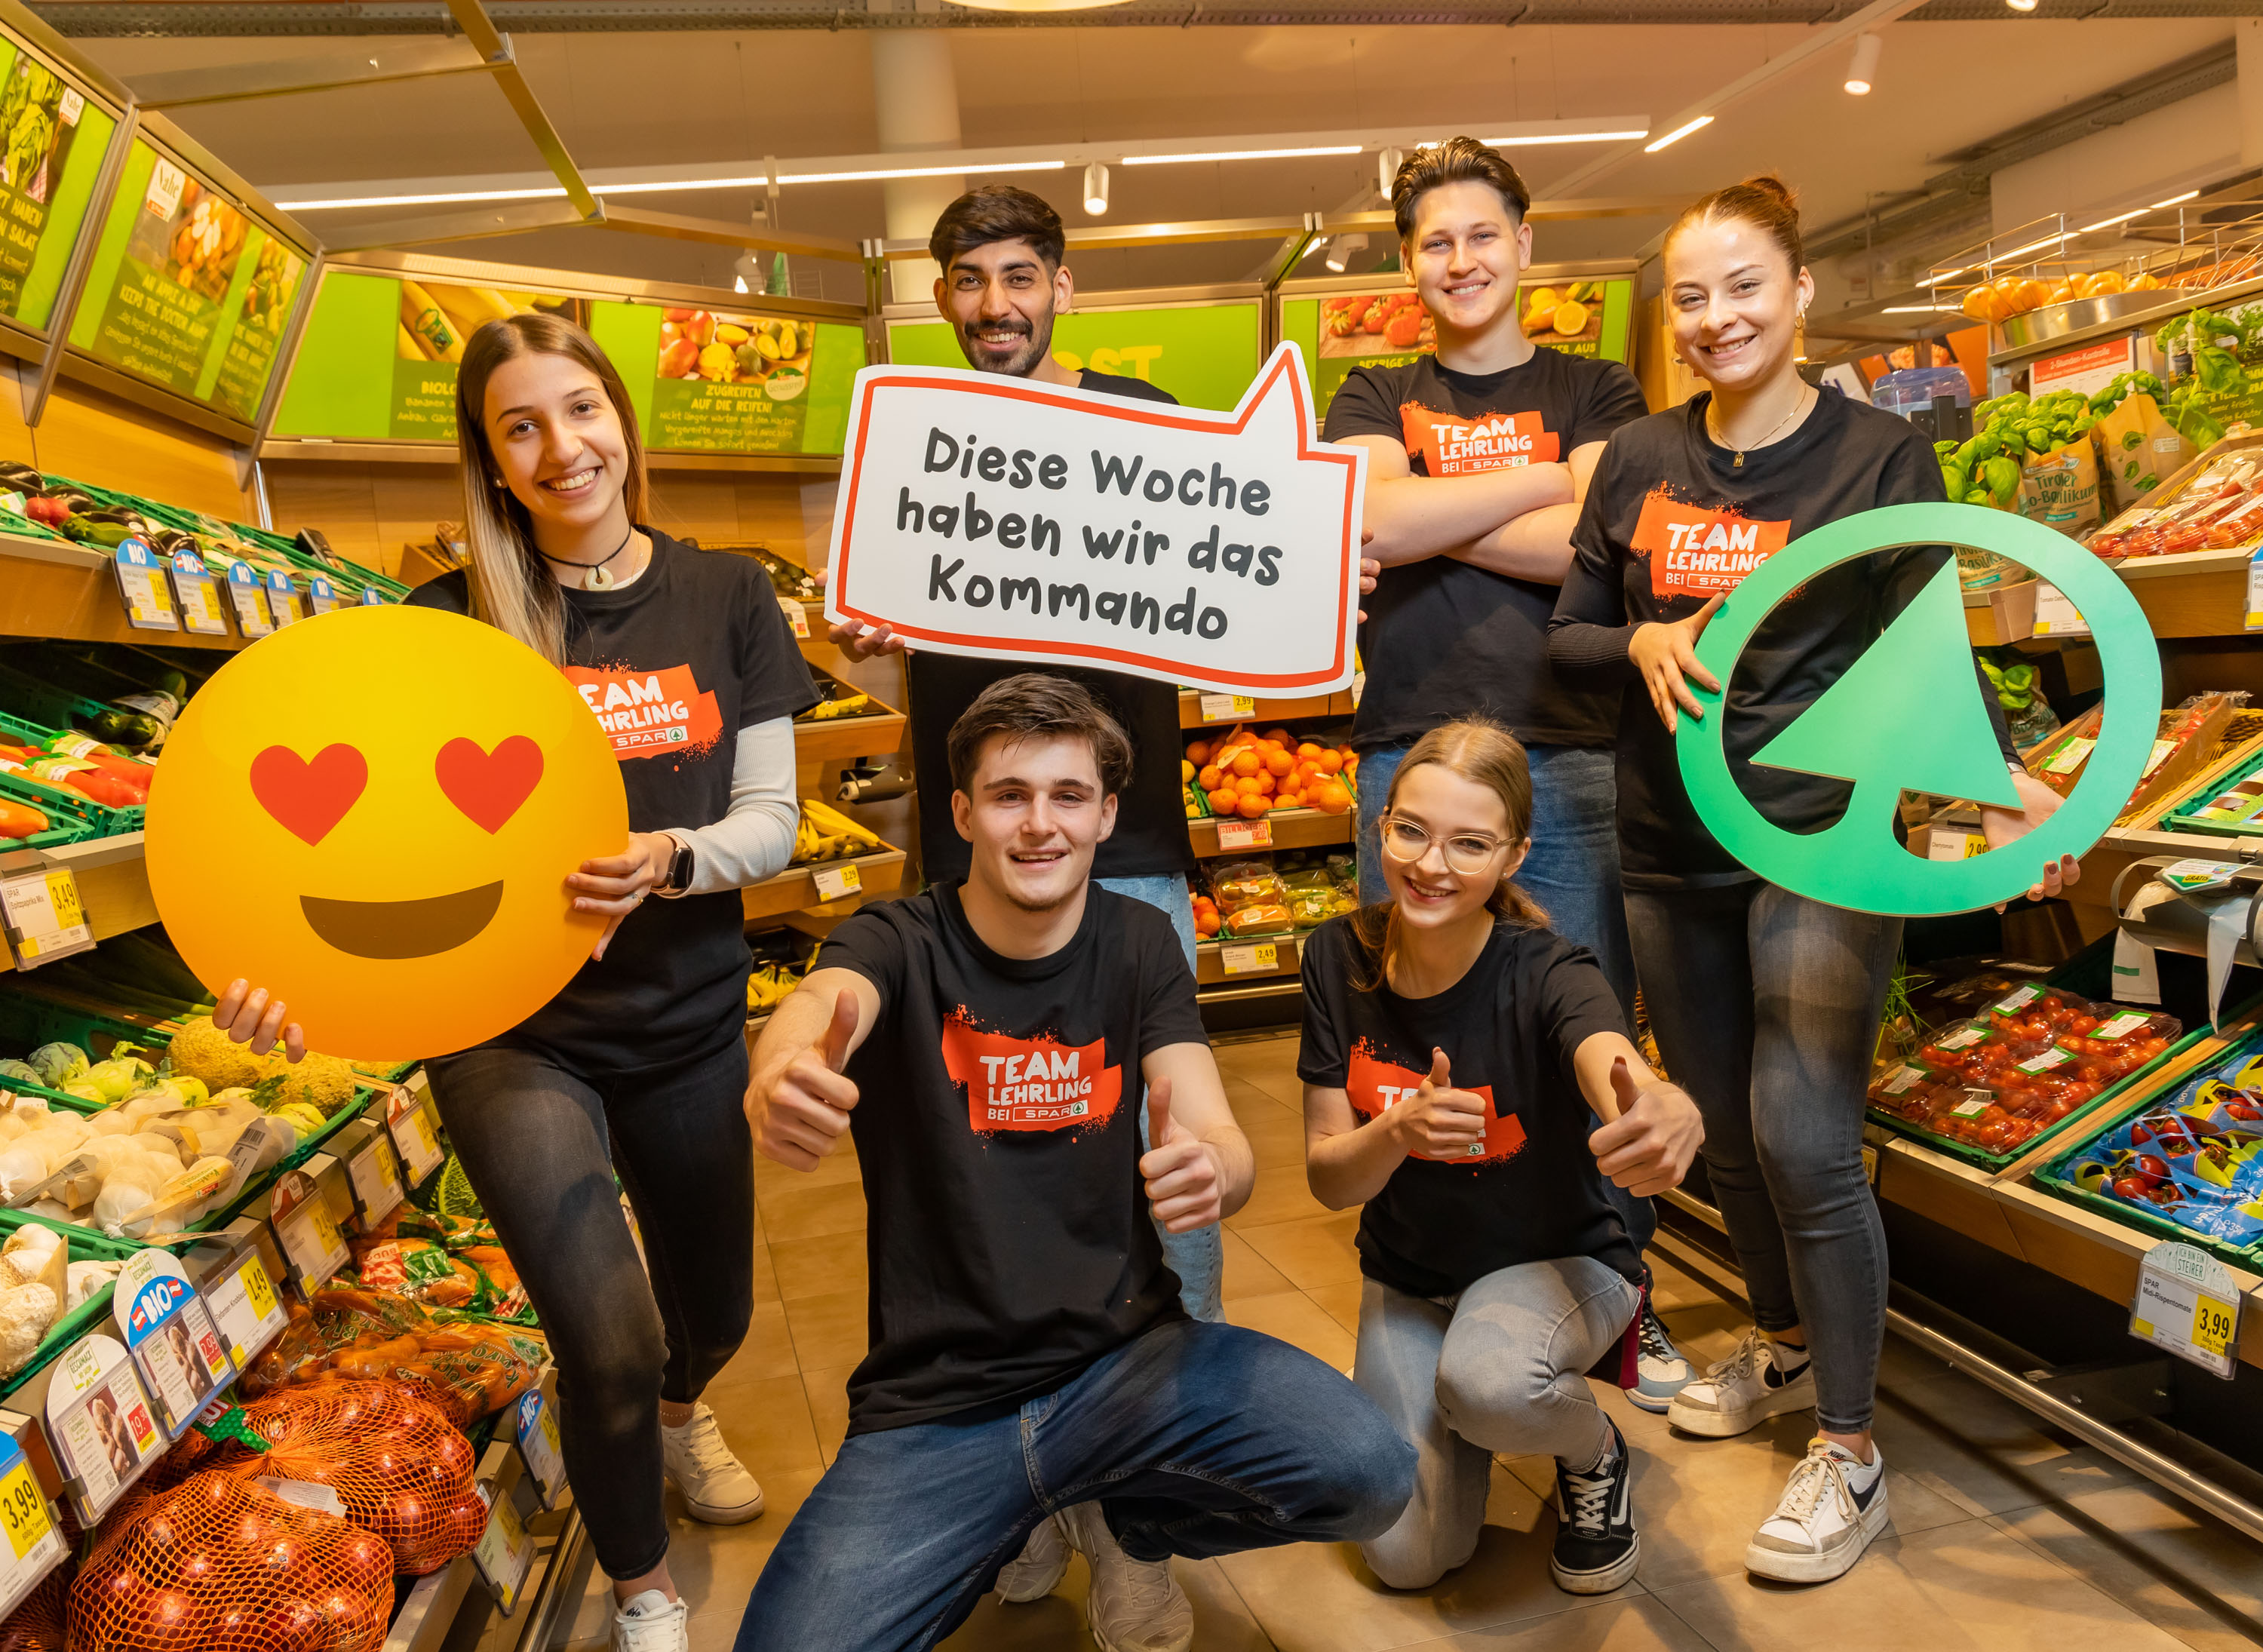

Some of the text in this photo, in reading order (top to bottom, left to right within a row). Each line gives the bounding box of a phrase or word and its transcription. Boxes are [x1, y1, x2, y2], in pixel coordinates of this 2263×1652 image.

[11, 198, 43, 229] HABEN
[9, 223, 38, 252] SALAT
[119, 284, 144, 309] KEEPS
[1574, 343, 1596, 354] AUS
[705, 385, 762, 398] ZUGREIFEN
[691, 398, 772, 413] AUF DIE REIFEN!
[741, 413, 754, 424] mit
[1430, 417, 1515, 444] TEAM
[1439, 434, 1533, 461] LEHRLING
[923, 426, 1271, 516] Diese Woche
[1442, 459, 1512, 474] BEI SPAR
[2034, 473, 2077, 490] Tiroler
[897, 486, 1283, 586] haben wir das
[1666, 523, 1758, 551] TEAM
[127, 543, 146, 565] BIO
[181, 554, 198, 573] BIO
[235, 565, 250, 584] BIO
[273, 573, 287, 589] BIO
[1666, 573, 1684, 585] BEI
[928, 553, 1229, 640] Kommando
[577, 676, 664, 713] EAM
[1236, 697, 1251, 706] 2,99
[597, 701, 689, 732] HRLING
[616, 732, 666, 747] SPAR
[7, 889, 20, 898] SPAR
[52, 883, 76, 913] 3,49
[1258, 949, 1274, 959] 2,49
[979, 1051, 1079, 1085] TEAM
[987, 1076, 1092, 1106] LEHRLING
[987, 1105, 1070, 1121] BEI SPAR
[2188, 1251, 2196, 1260] BIN
[2178, 1259, 2203, 1278] STEIRER
[247, 1268, 267, 1302] 1,49
[2144, 1277, 2160, 1289] SPAR
[140, 1283, 172, 1325] BIO
[2143, 1287, 2192, 1313] Midi-Rispentomate
[2200, 1308, 2230, 1339] 3,99
[69, 1350, 92, 1374] GESCHMACK
[521, 1396, 536, 1426] BIO
[1828, 1450, 1846, 1460] NIKE
[3, 1480, 38, 1529] 3,99
[32, 1516, 45, 1530] Tasse
